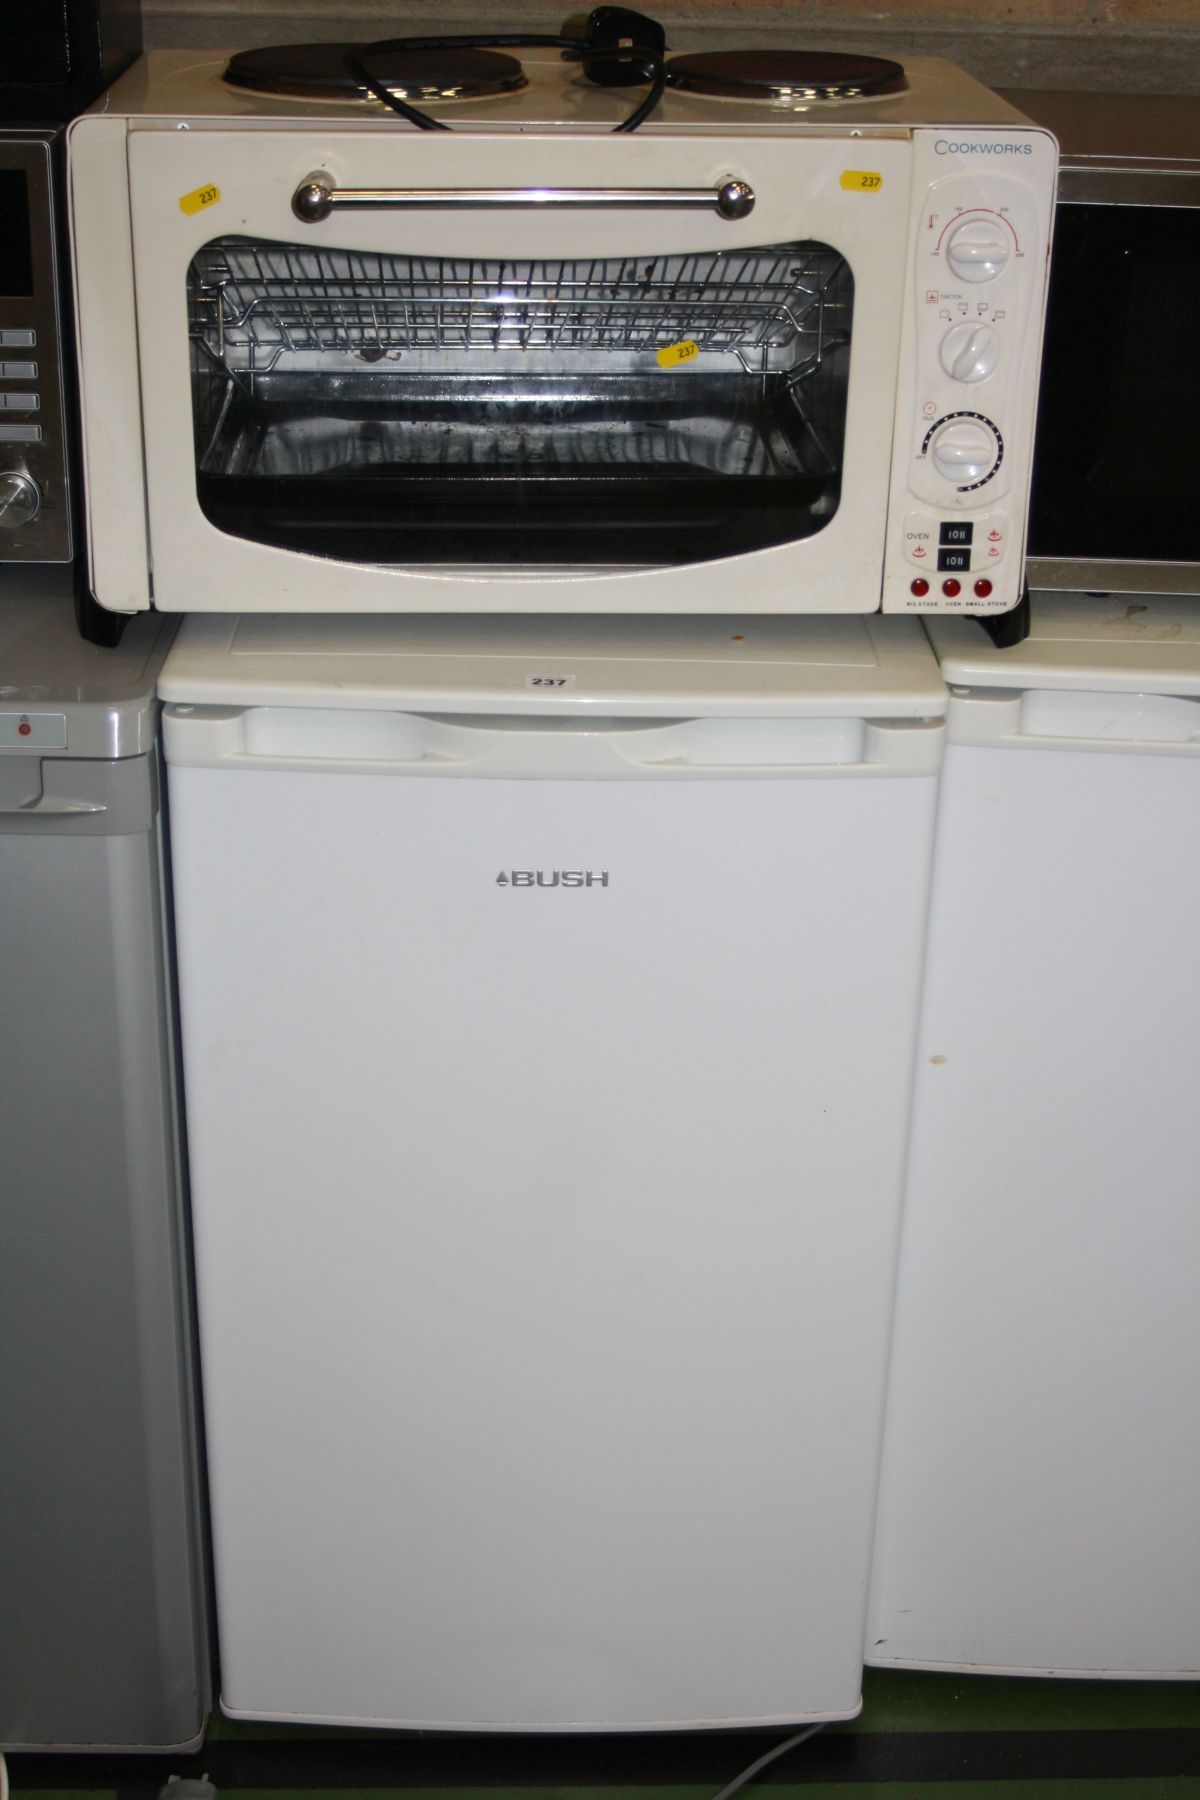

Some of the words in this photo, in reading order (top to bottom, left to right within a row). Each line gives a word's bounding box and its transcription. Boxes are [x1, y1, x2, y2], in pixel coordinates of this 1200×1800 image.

[861, 176, 881, 188] 237
[199, 187, 217, 204] 237
[678, 344, 695, 359] 237
[906, 532, 929, 540] OVEN
[531, 677, 567, 687] 237
[511, 869, 609, 888] BUSH
